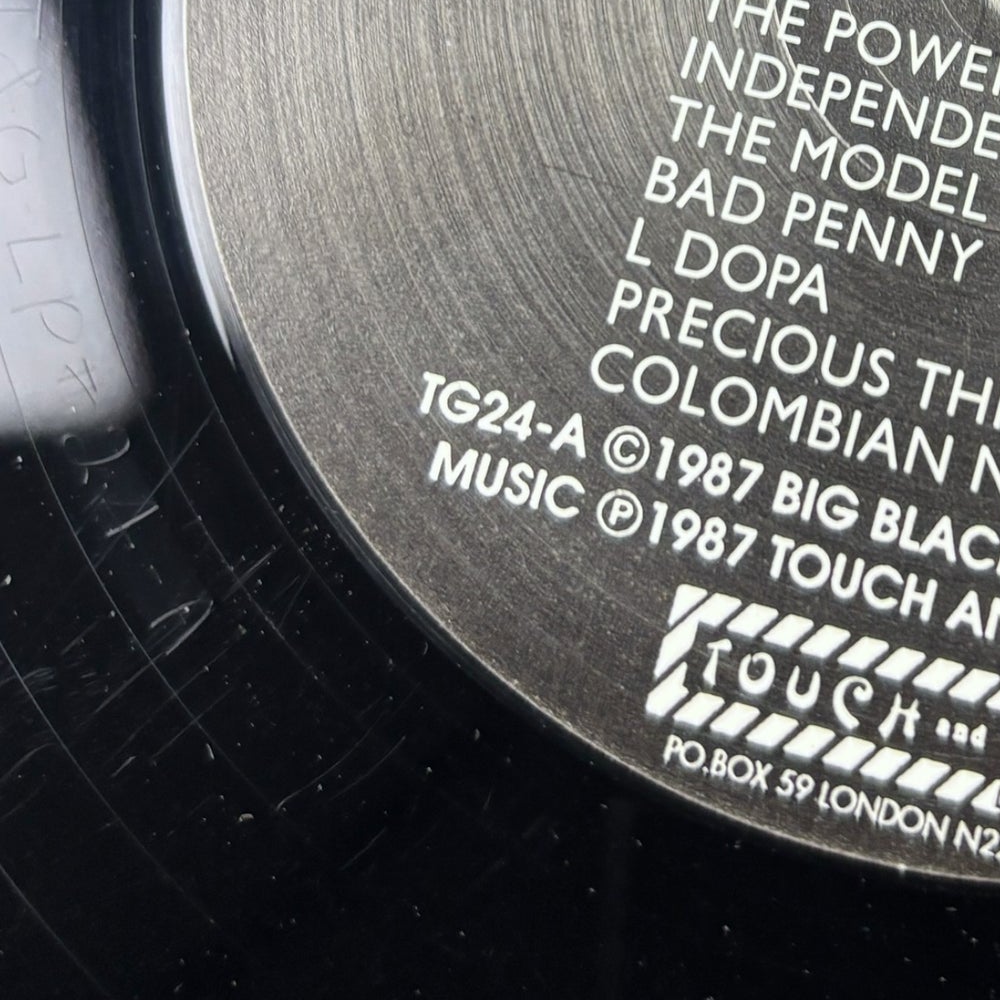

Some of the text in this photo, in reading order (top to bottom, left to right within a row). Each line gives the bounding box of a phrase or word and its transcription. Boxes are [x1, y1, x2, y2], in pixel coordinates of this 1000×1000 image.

[643, 155, 984, 282] BAD PENNY
[668, 93, 777, 165] THE
[789, 128, 988, 223] MODEL
[625, 216, 828, 314] L DOPA
[606, 278, 895, 397] PRECIOUS
[418, 370, 587, 459] TG24-A
[771, 470, 860, 531] BIG
[589, 343, 954, 484] COLOMBIAN
[427, 440, 586, 519] MUSIC
[769, 534, 938, 622] TOUCH
[702, 638, 921, 739] TOUCH
[775, 768, 815, 801] 59
[817, 780, 951, 844] LONDON
